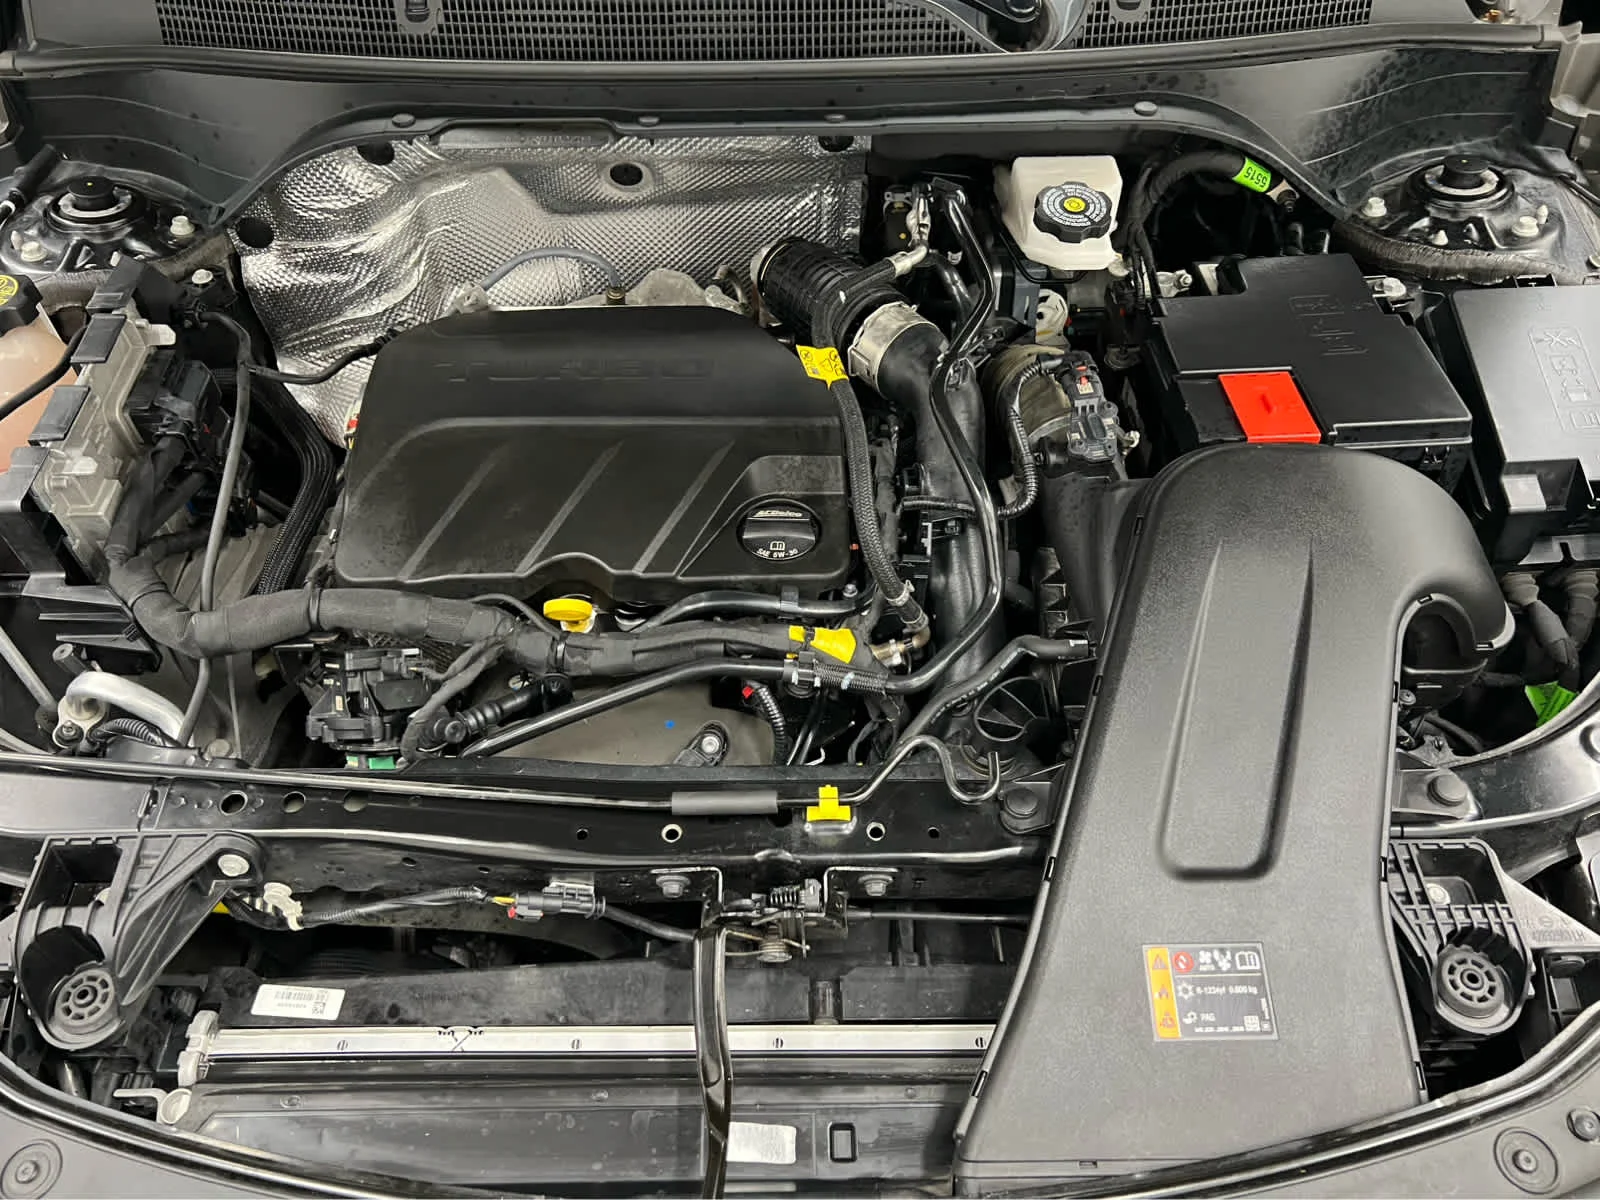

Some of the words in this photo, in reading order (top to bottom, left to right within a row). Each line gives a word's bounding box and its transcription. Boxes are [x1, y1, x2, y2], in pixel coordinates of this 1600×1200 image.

[1244, 166, 1268, 188] 5515
[434, 359, 713, 384] TURBO
[756, 548, 770, 558] SAE
